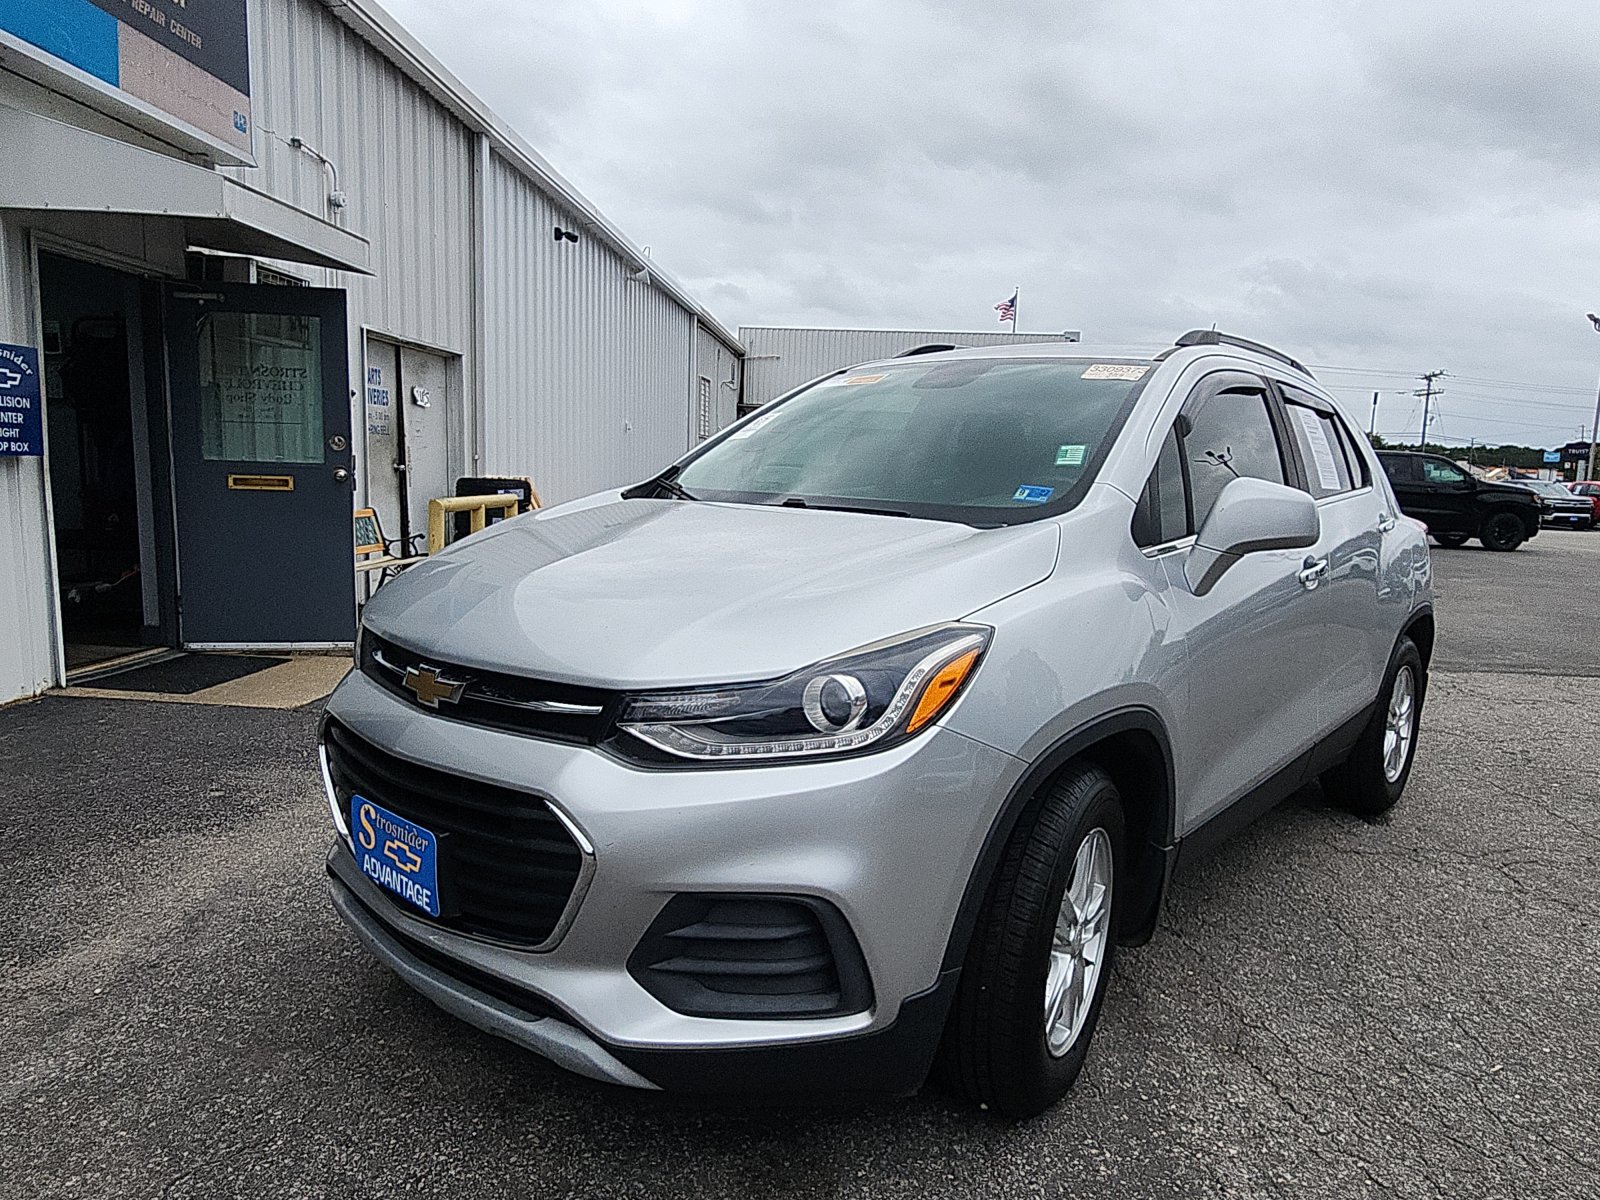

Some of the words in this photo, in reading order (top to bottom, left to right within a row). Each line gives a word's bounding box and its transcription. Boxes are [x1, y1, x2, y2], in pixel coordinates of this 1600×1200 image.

[131, 0, 166, 27] REPAIR
[170, 19, 203, 50] CENTER
[11, 442, 30, 452] BOX
[358, 803, 429, 852] Strosnider
[363, 853, 432, 913] ADVANTAGE
